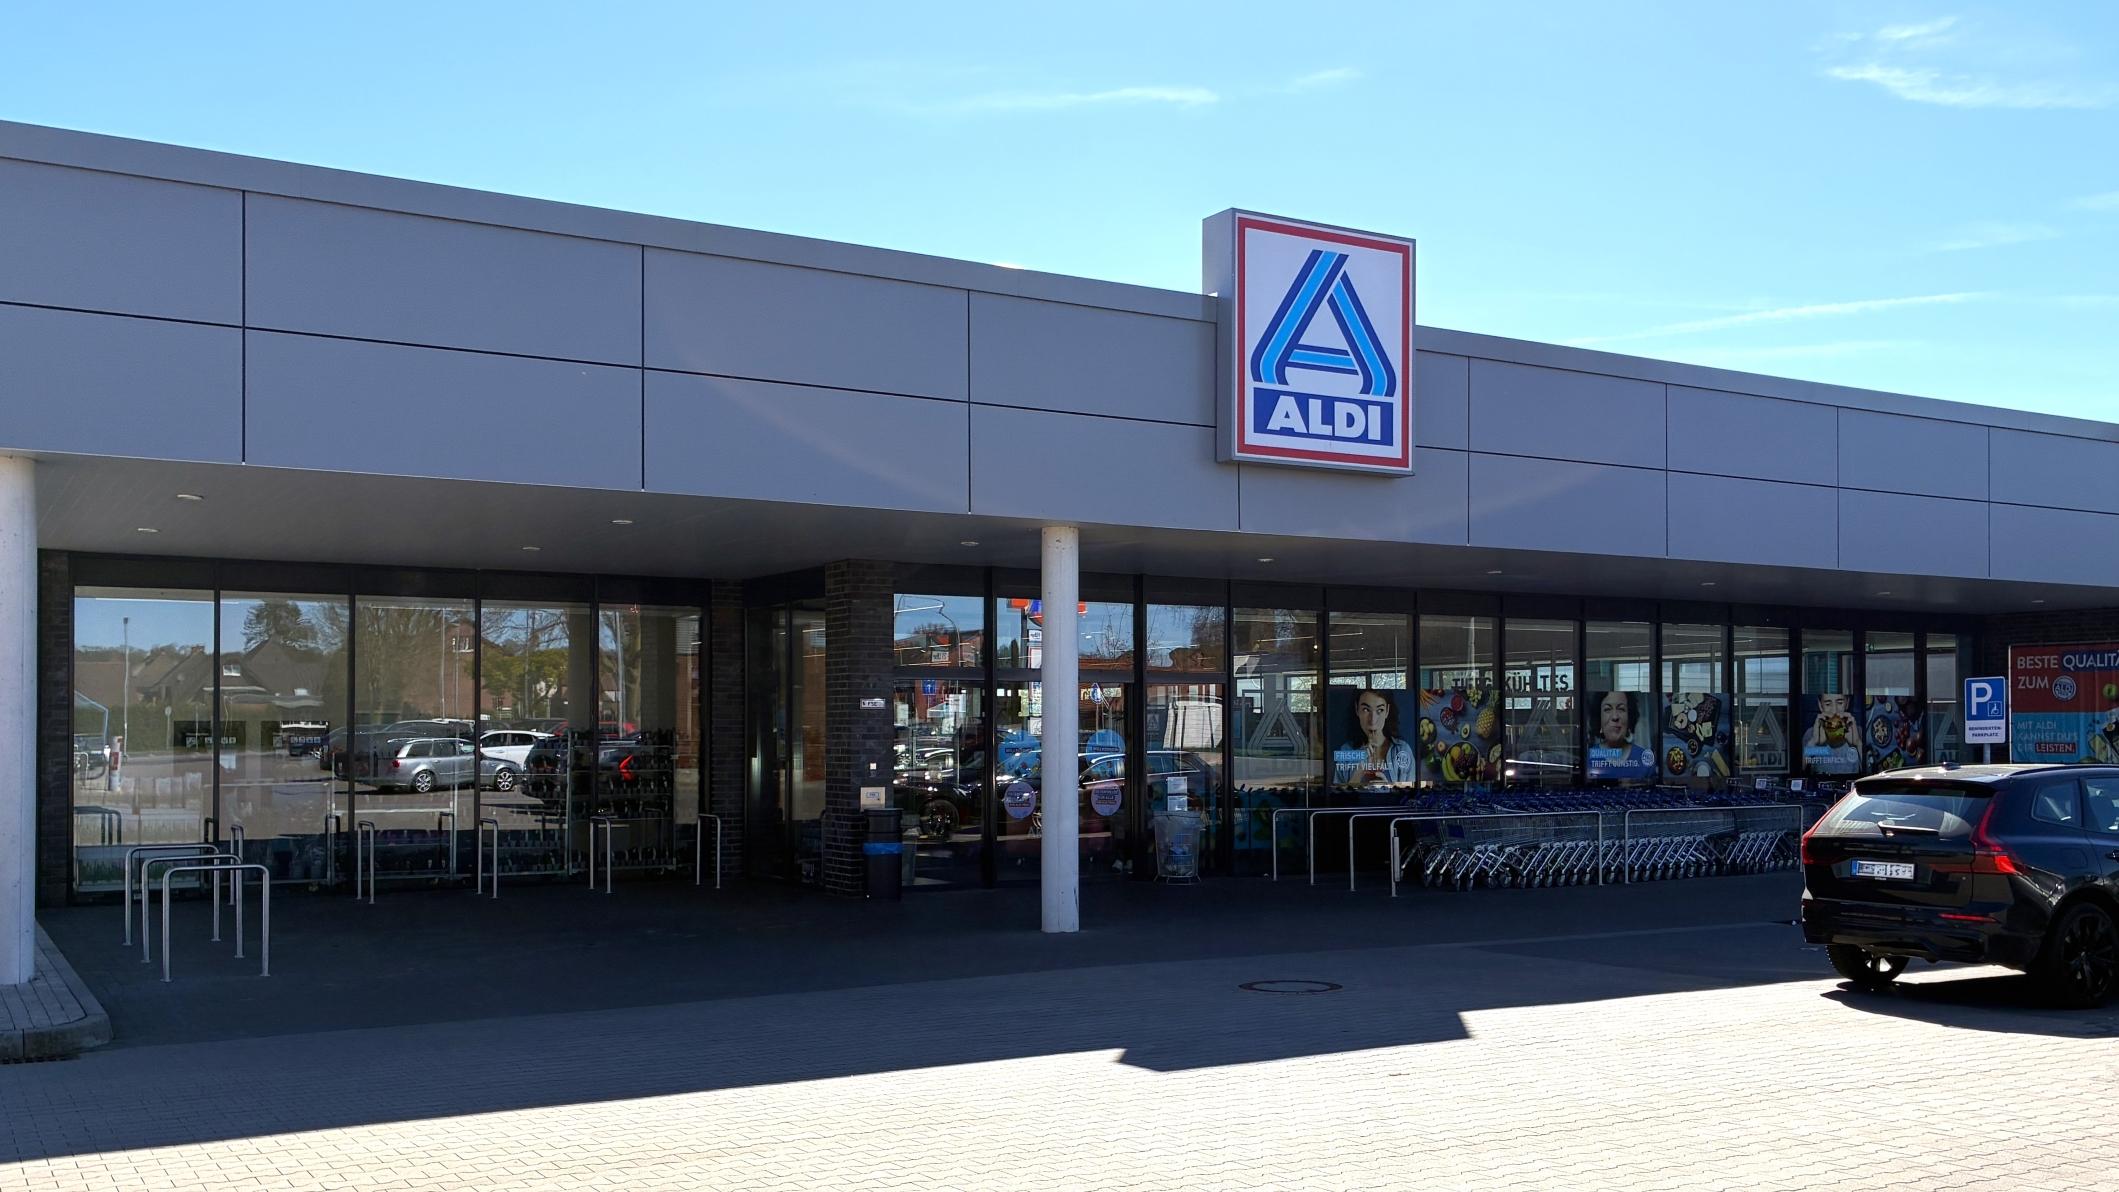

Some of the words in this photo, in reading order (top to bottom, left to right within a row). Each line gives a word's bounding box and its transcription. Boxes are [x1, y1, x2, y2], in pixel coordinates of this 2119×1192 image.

[1266, 395, 1381, 441] ALDI
[2017, 655, 2059, 669] BESTE
[2017, 676, 2049, 689] ZUM
[1971, 682, 1993, 716] P
[2016, 720, 2032, 729] MIT
[2036, 720, 2057, 730] ALDI
[1335, 751, 1366, 760] FRISCHE
[1335, 762, 1360, 771] TRIFFT
[1591, 759, 1611, 768] TRIFFT
